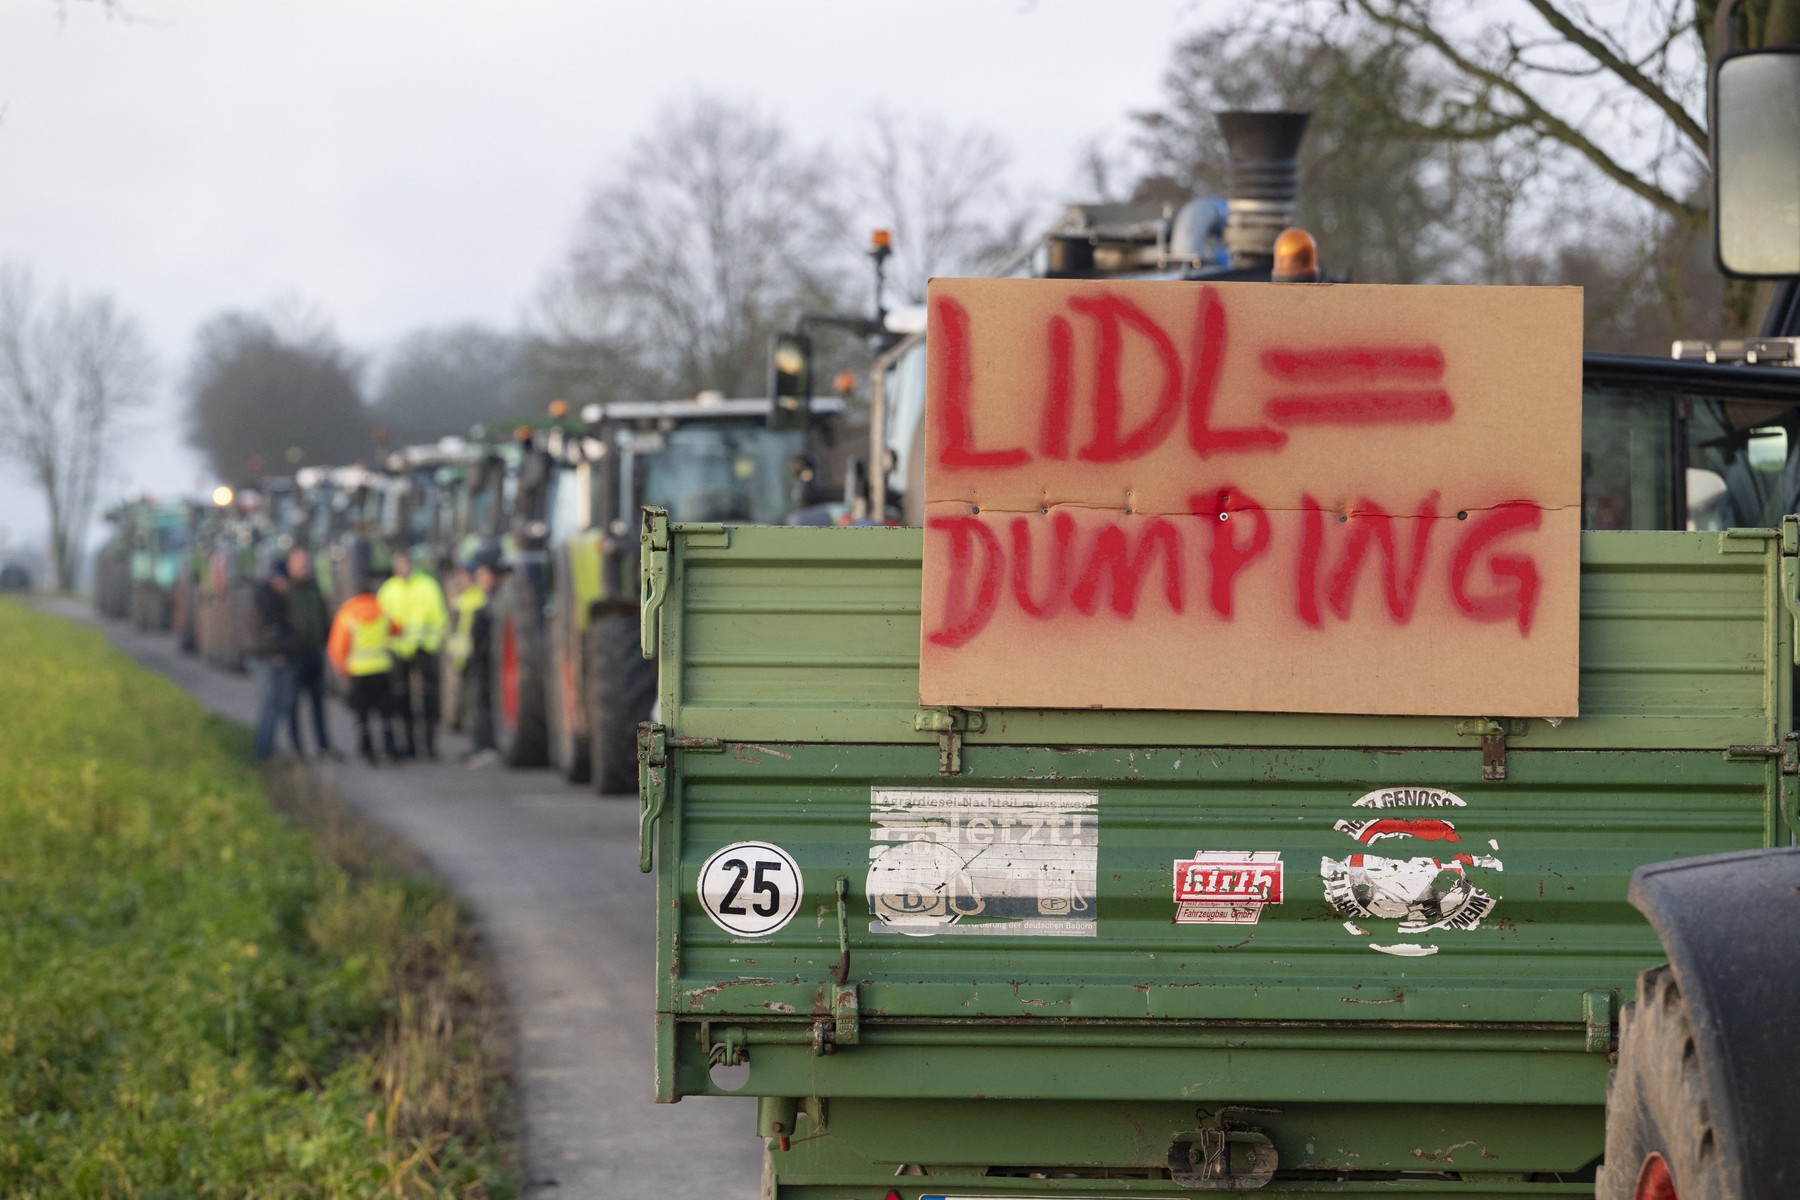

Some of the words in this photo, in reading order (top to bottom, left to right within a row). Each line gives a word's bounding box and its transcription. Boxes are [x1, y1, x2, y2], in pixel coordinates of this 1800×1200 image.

[926, 486, 1542, 647] DUMPING
[719, 858, 782, 918] 25
[1023, 920, 1063, 930] deutschen
[1066, 921, 1093, 930] Bauern
[1183, 908, 1228, 921] Fahrzeugbau
[1230, 908, 1253, 919] GmbH
